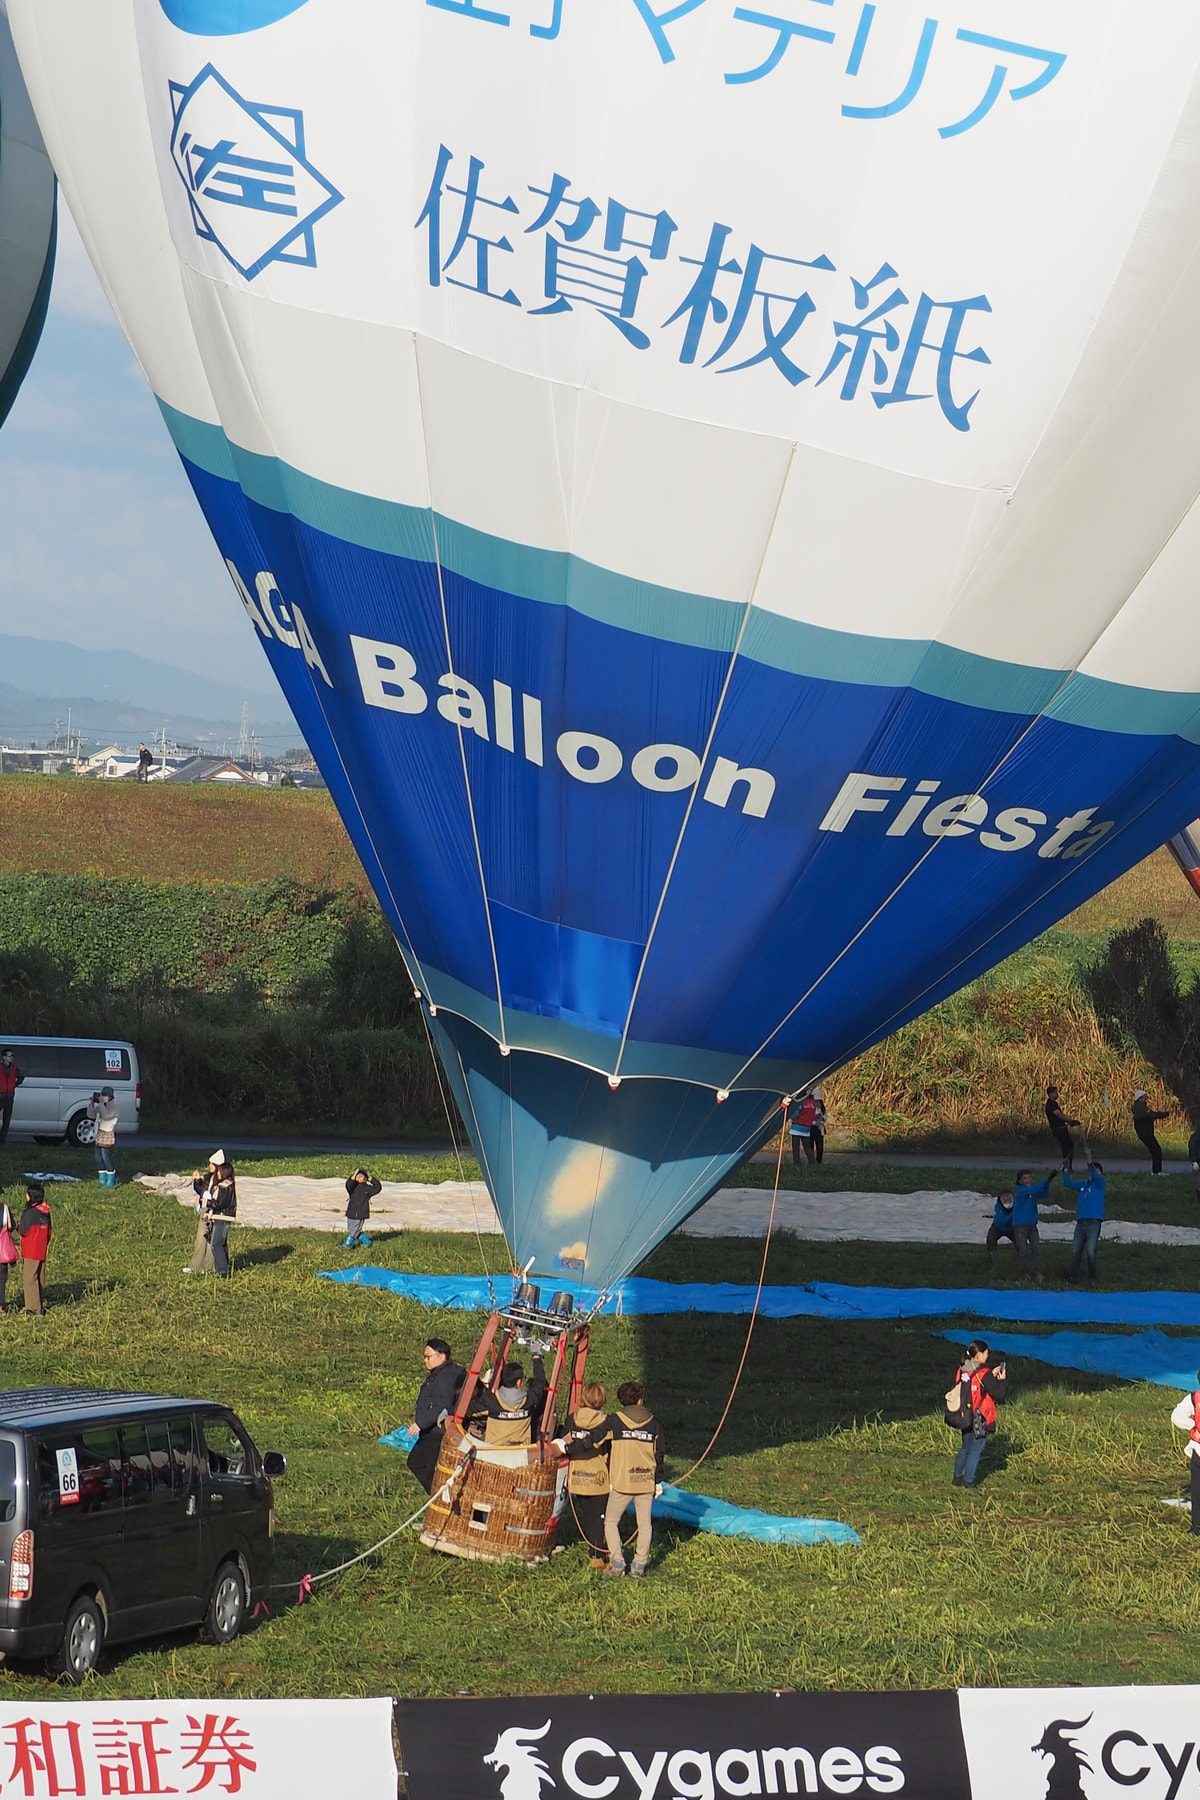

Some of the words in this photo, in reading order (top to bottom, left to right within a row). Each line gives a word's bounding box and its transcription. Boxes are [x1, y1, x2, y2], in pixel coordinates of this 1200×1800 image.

[426, 0, 1068, 140] マテリア
[413, 142, 994, 433] 佐賀板紙
[349, 633, 777, 820] Balloon
[818, 772, 1116, 861] Fiesta
[62, 1472, 77, 1492] 66
[0, 1713, 257, 1797] 和証券
[561, 1736, 906, 1800] Cygames
